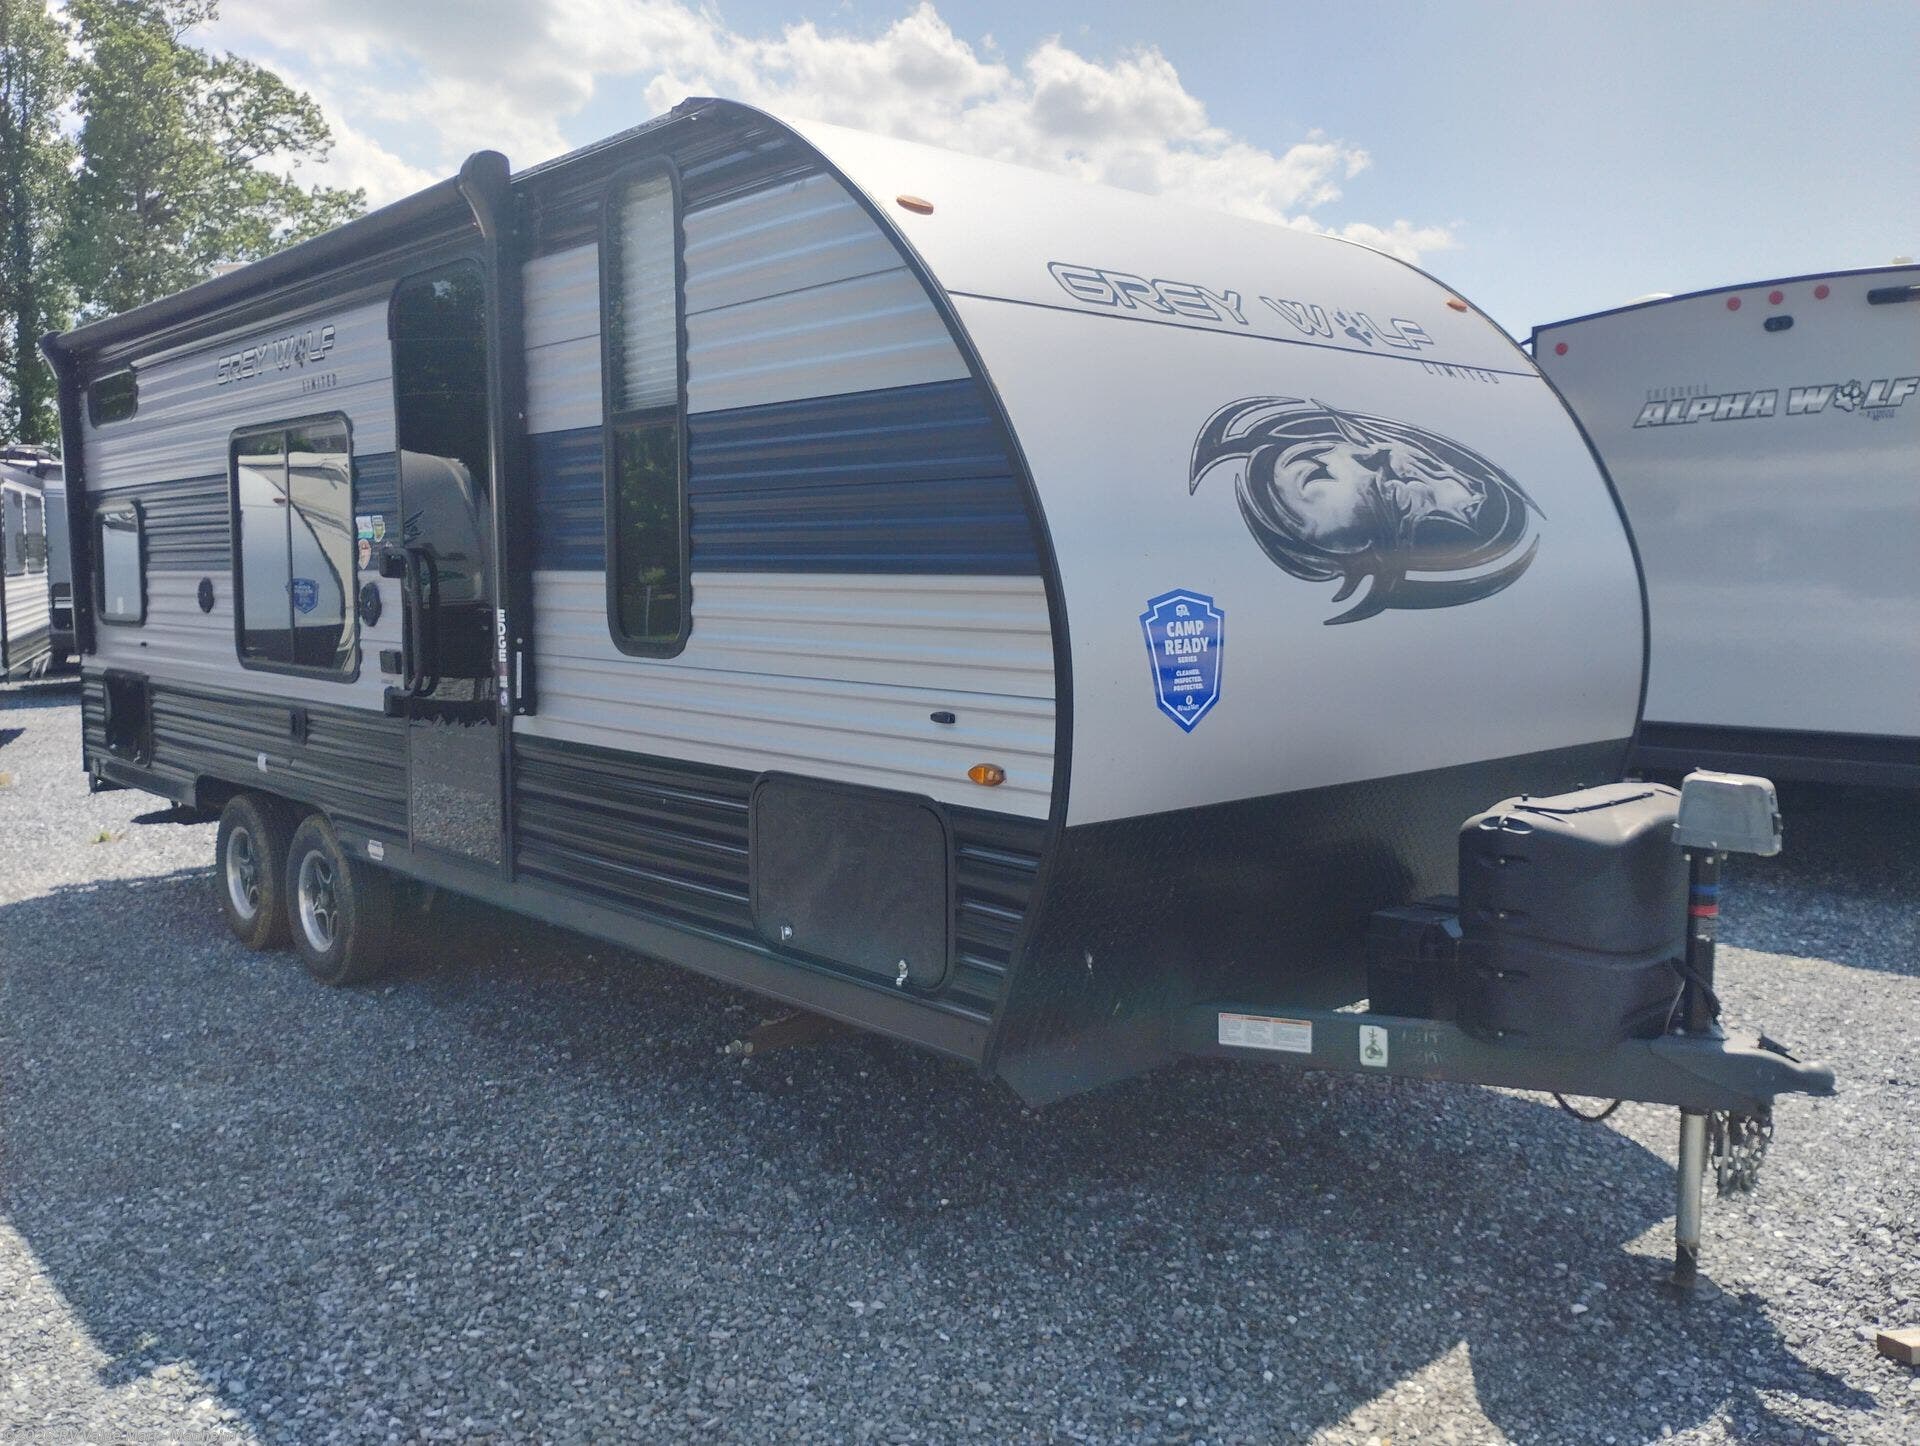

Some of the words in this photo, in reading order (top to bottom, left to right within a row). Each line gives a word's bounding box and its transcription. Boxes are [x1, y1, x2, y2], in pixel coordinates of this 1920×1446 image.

[1046, 261, 1249, 325] GREY
[216, 343, 268, 386] GREY
[1420, 360, 1500, 384] LIMITED
[1632, 389, 1779, 428] ALPHA
[497, 608, 507, 663] EDGE
[1164, 637, 1210, 656] READY
[1166, 619, 1205, 638] CAMP
